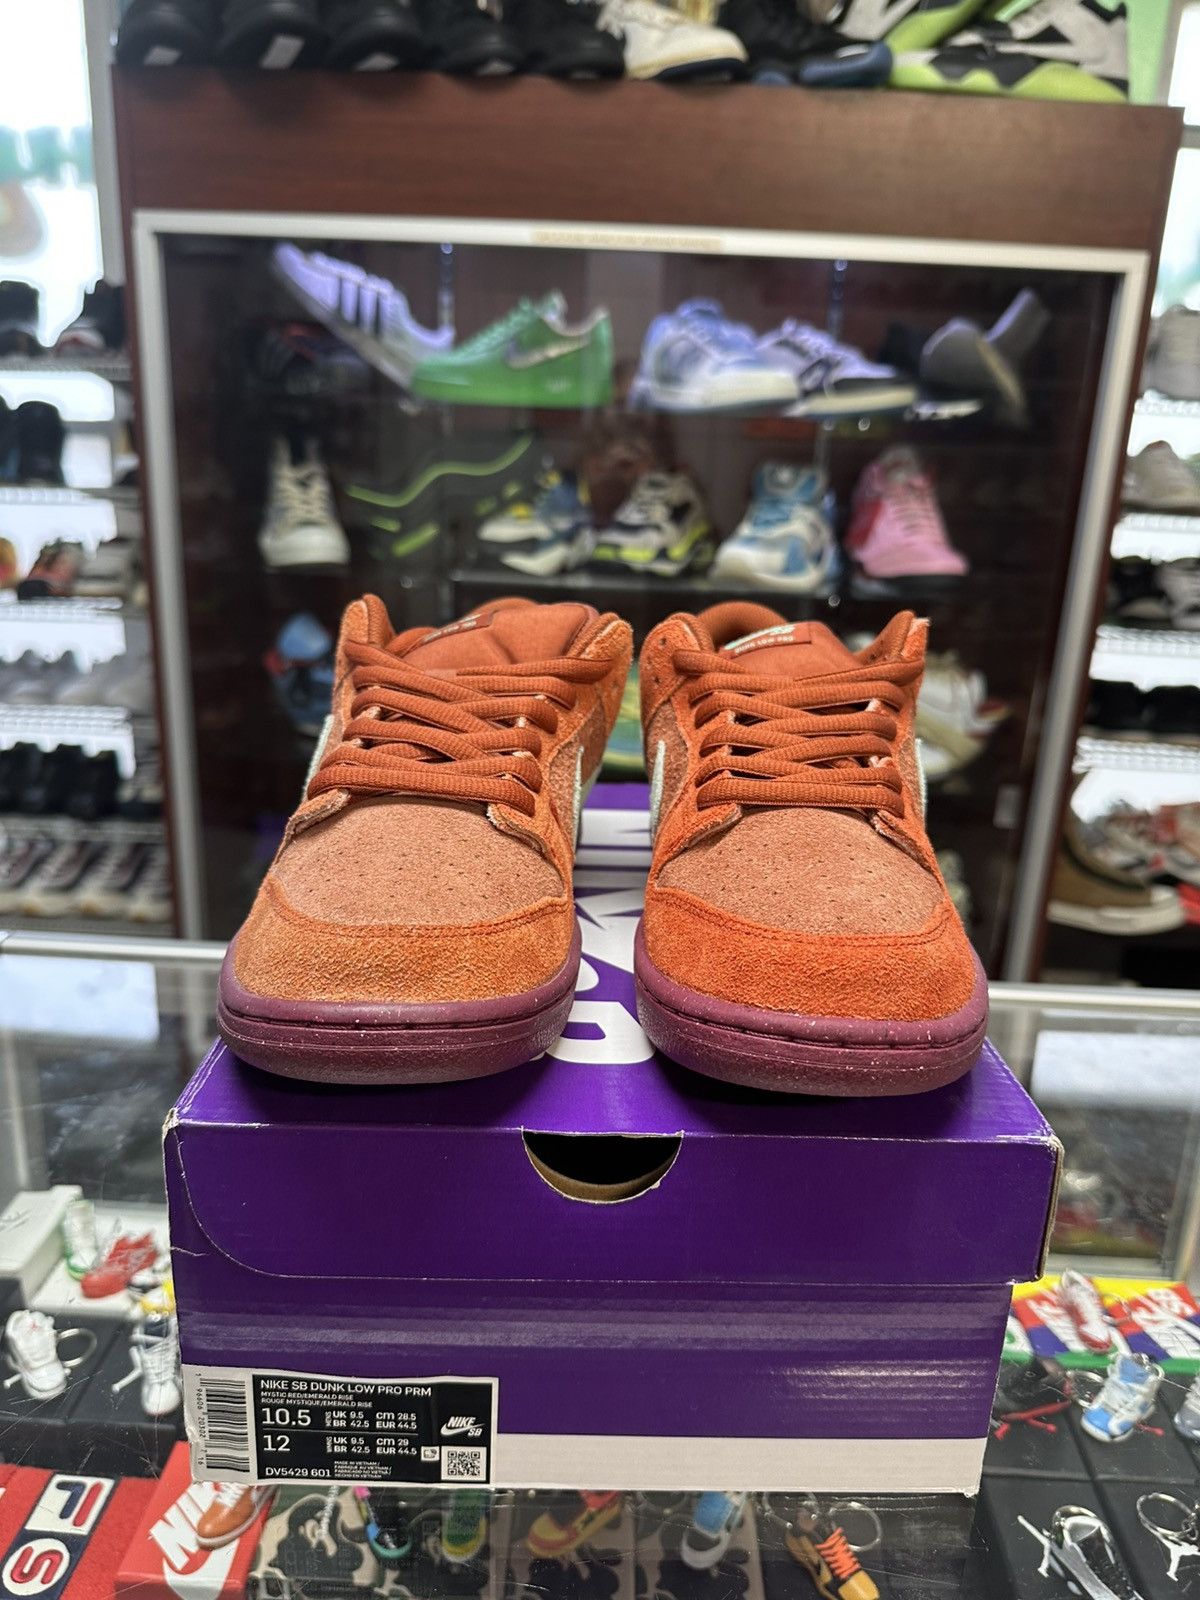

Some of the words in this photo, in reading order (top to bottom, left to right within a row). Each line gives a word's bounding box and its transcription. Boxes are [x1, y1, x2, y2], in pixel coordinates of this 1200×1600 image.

[261, 1380, 289, 1390] NIKE
[292, 1381, 308, 1391] SB
[311, 1382, 345, 1392] DUNK
[348, 1384, 375, 1394] LOW
[377, 1385, 402, 1395] PRO
[405, 1386, 432, 1397] PRM
[261, 1407, 312, 1426] 10.5
[332, 1411, 347, 1419] UK
[376, 1412, 395, 1420] cm
[397, 1412, 416, 1421] 28.5
[333, 1419, 346, 1427] BR
[350, 1420, 370, 1428] 42.5
[376, 1420, 396, 1429] EUR
[397, 1421, 417, 1430] 44.5
[447, 1416, 476, 1427] NIKE
[467, 1428, 483, 1437] SB
[263, 1434, 291, 1452] 12
[333, 1436, 347, 1444] UK
[376, 1438, 395, 1446] cm
[397, 1438, 409, 1446] 29
[334, 1445, 347, 1453] BR
[351, 1445, 370, 1454] 42.5
[376, 1446, 396, 1454] EUR
[397, 1447, 417, 1455] 44.5
[265, 1467, 309, 1477] DV5429
[311, 1469, 331, 1477] 601
